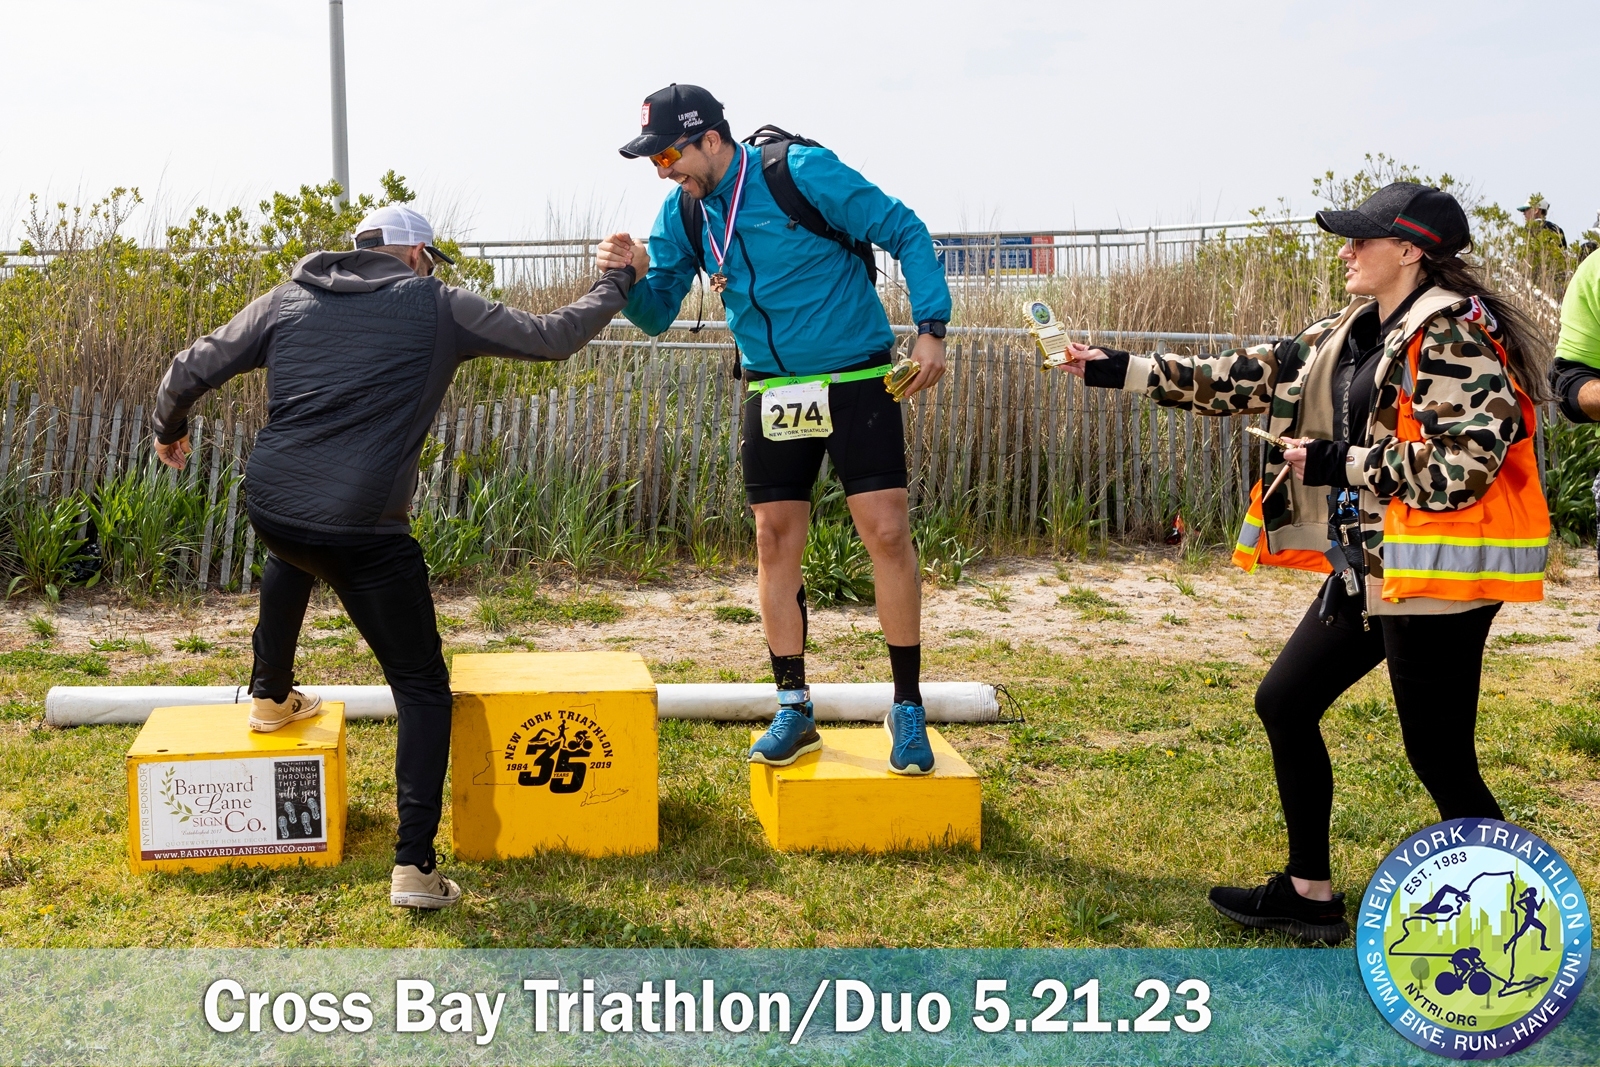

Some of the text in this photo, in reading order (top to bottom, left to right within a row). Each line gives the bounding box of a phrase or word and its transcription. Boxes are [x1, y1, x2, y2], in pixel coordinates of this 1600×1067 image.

[769, 401, 823, 430] 274
[504, 710, 613, 760] NEW YORK TRIATHLON
[506, 763, 528, 771] 1984
[518, 742, 592, 794] 35
[590, 761, 612, 769] 2019
[174, 775, 254, 797] Barnyard
[279, 786, 318, 803] with you
[140, 768, 150, 846] NYTRI SPONSOR
[195, 793, 252, 814] Lane
[192, 810, 267, 833] SIGN Co.
[154, 845, 315, 860] www.BARNYARDLANESIGNCO.com
[165, 839, 219, 847] QUOTEWORTHY
